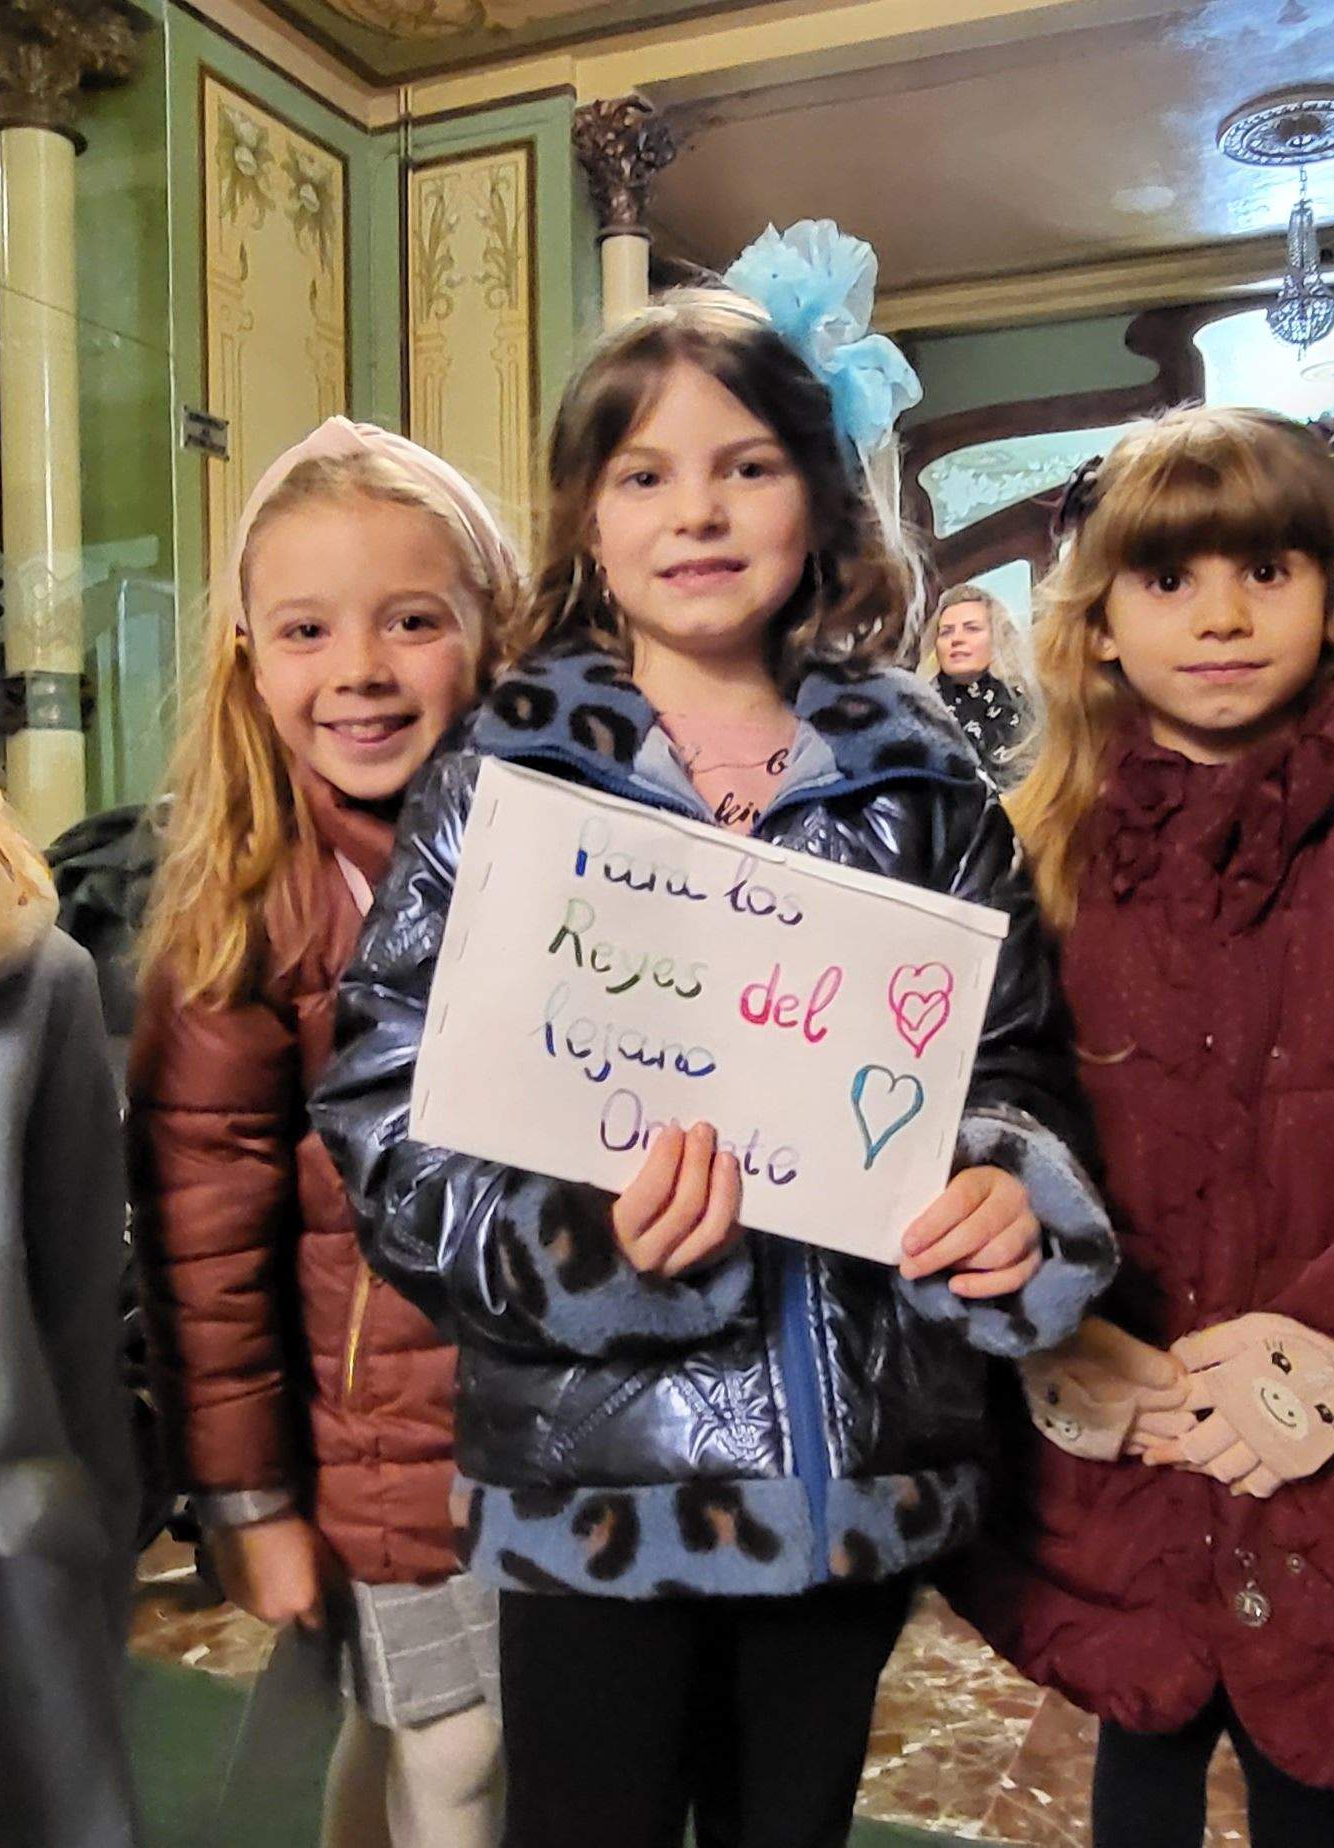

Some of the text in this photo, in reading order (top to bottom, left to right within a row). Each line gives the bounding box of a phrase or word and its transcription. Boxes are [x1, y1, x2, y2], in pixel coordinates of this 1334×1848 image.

[575, 817, 804, 926] Para los
[529, 962, 716, 1083] lejano
[547, 898, 843, 1043] Reyes del
[600, 1088, 800, 1186] Orte
